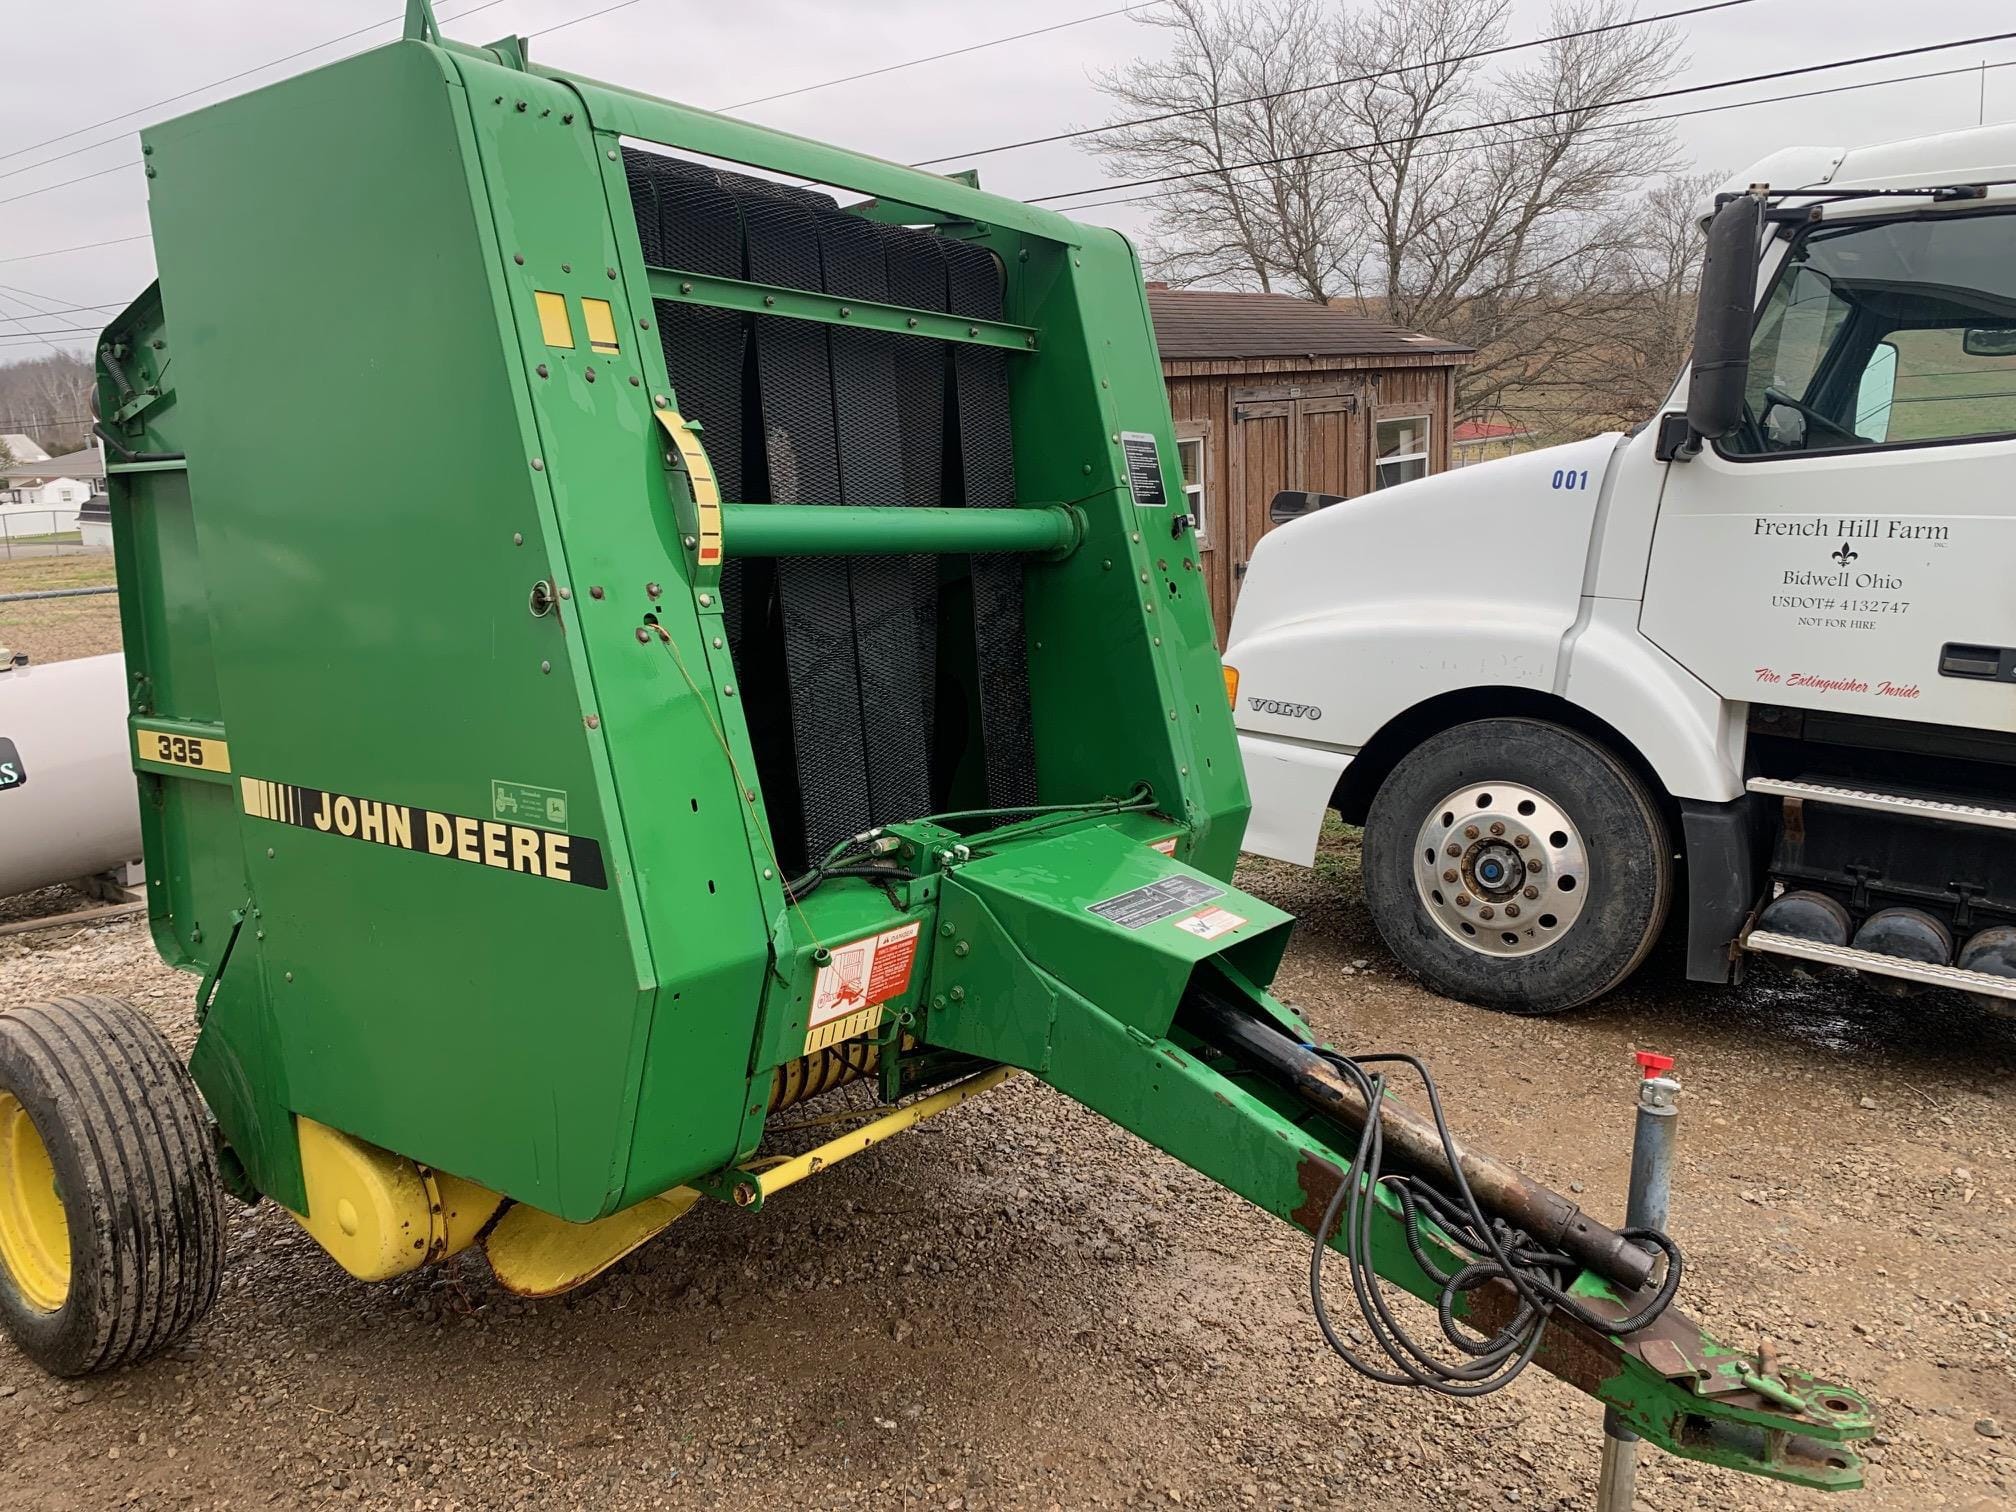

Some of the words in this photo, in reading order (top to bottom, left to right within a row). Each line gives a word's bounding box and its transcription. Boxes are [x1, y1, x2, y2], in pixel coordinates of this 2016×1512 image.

[1552, 470, 1588, 491] 001
[1754, 518, 1828, 537] French
[1837, 520, 1879, 538] Hill
[1887, 521, 1949, 540] Farm
[1783, 570, 1848, 587] Bidwell
[1855, 573, 1902, 590] Ohio
[1771, 596, 1835, 609] USDOT#
[1839, 600, 1910, 614] 4132747
[1798, 617, 1823, 627] NOT
[1825, 618, 1847, 628] FOR
[1850, 620, 1877, 631] HIRE
[1754, 668, 1781, 684] Fire
[1786, 673, 1868, 694] Extinguisher
[1876, 681, 1920, 699] Inside
[1248, 697, 1322, 720] VOLVO
[158, 735, 204, 766] 335
[313, 792, 413, 849] JOHN
[425, 812, 572, 882] DEERE
[890, 929, 914, 942] DANGER
